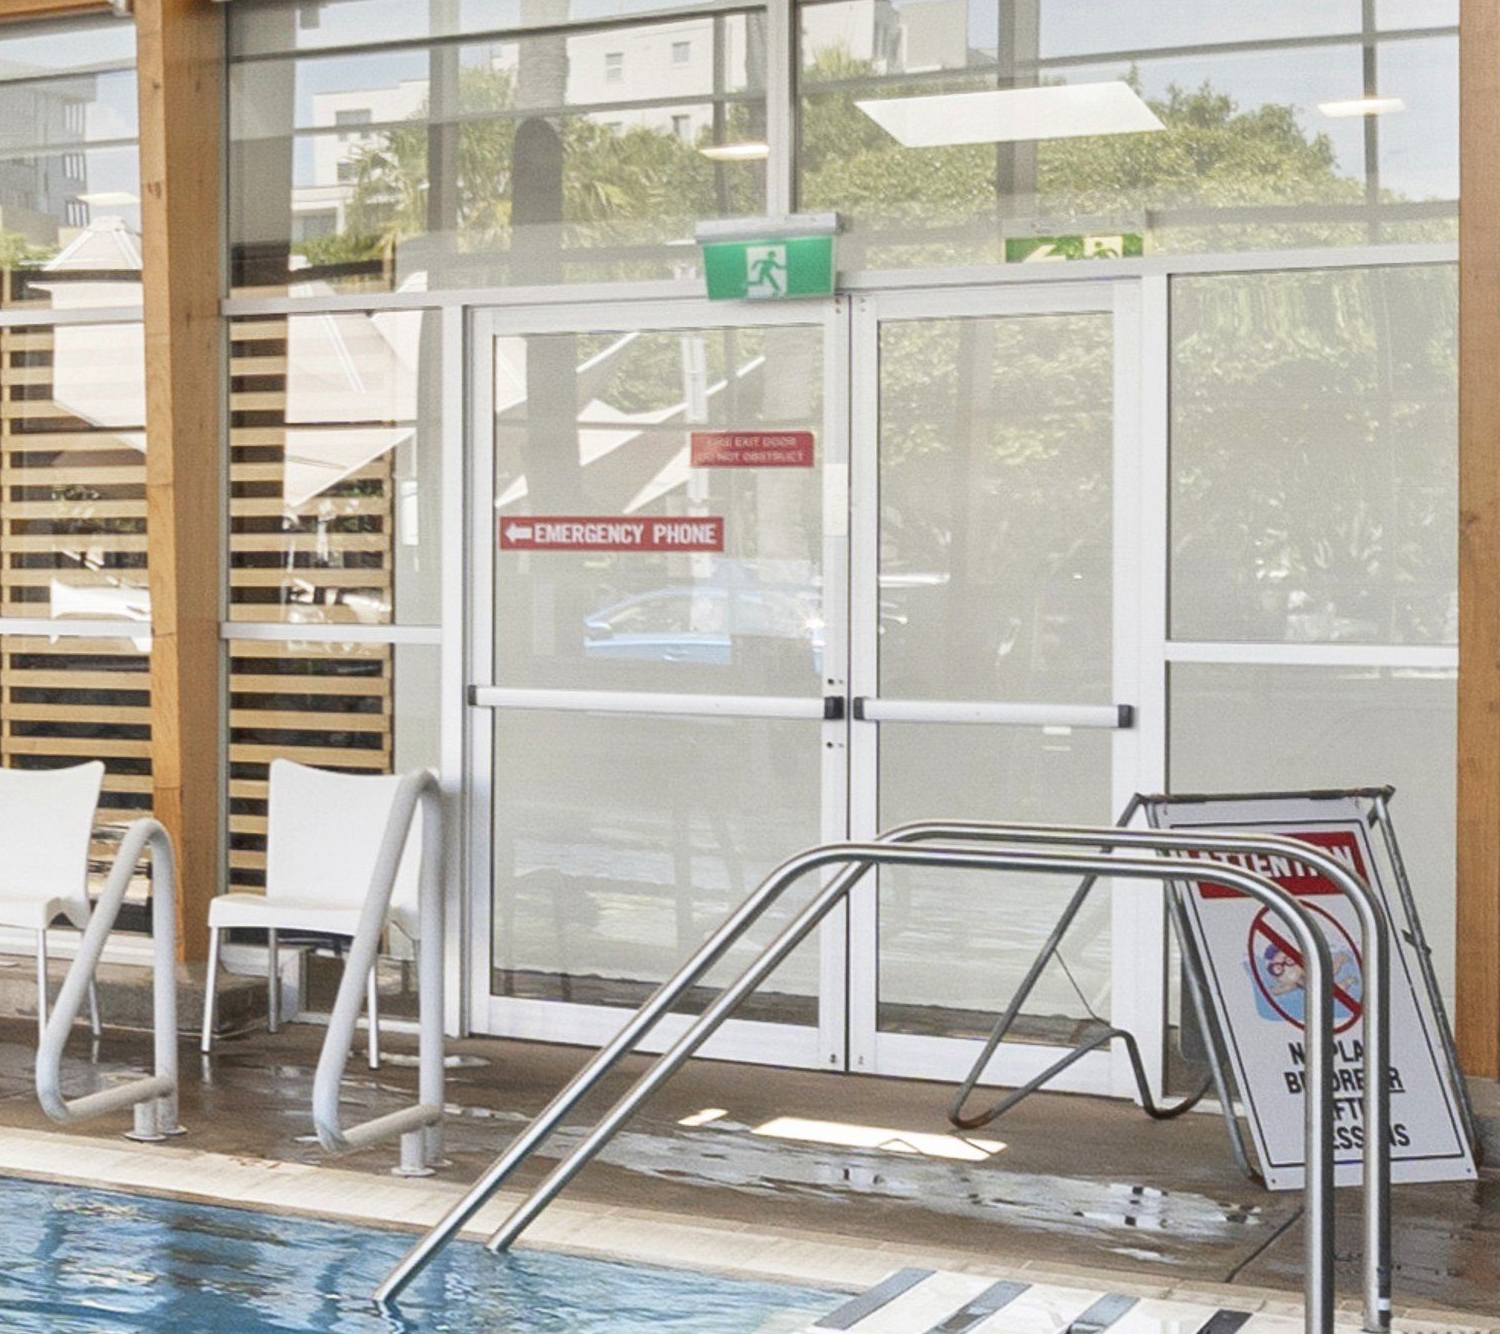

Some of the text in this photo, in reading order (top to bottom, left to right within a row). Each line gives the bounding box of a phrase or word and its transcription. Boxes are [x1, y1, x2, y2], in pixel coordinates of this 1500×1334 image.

[735, 436, 760, 447] EXIT
[535, 522, 717, 545] EMERGENCY PHONE
